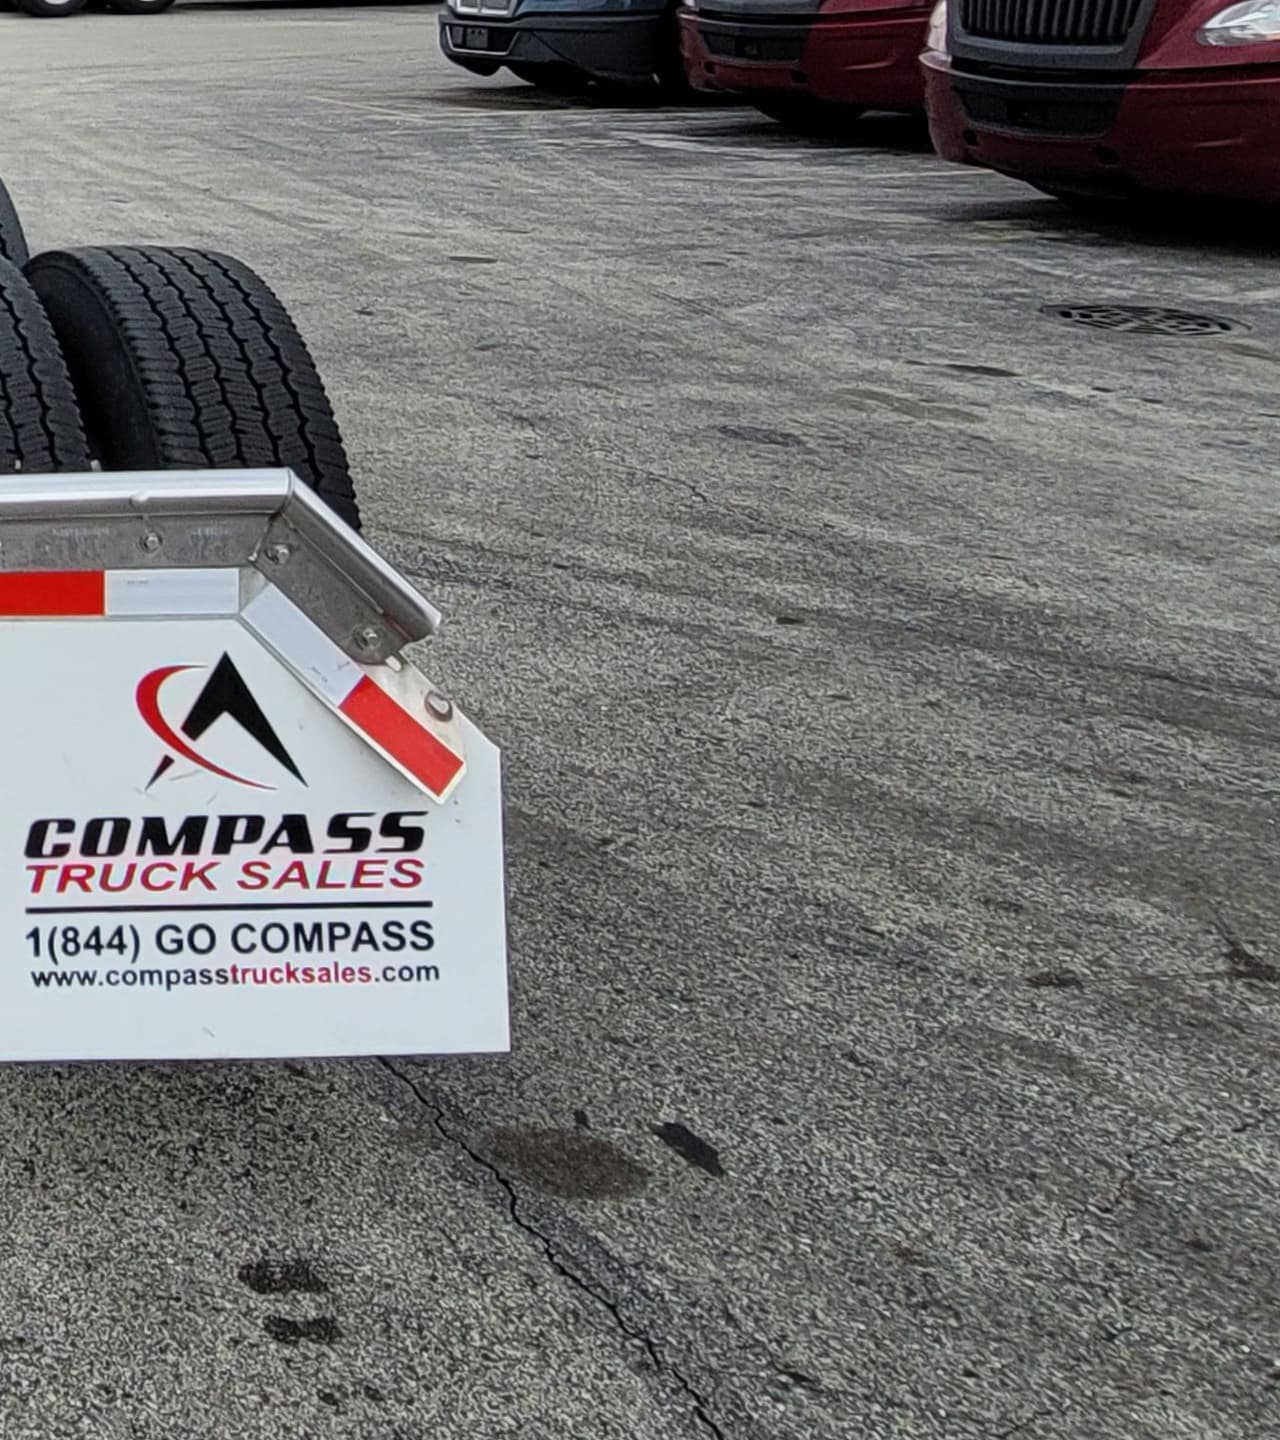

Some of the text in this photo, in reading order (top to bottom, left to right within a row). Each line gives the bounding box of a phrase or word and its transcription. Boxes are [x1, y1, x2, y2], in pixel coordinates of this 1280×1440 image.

[23, 810, 429, 859] COMPASS
[25, 858, 425, 894] TRUCK SALES
[25, 919, 435, 966] 1(844) GO COMPASS
[30, 961, 441, 993] www.compasstrucksales.com
